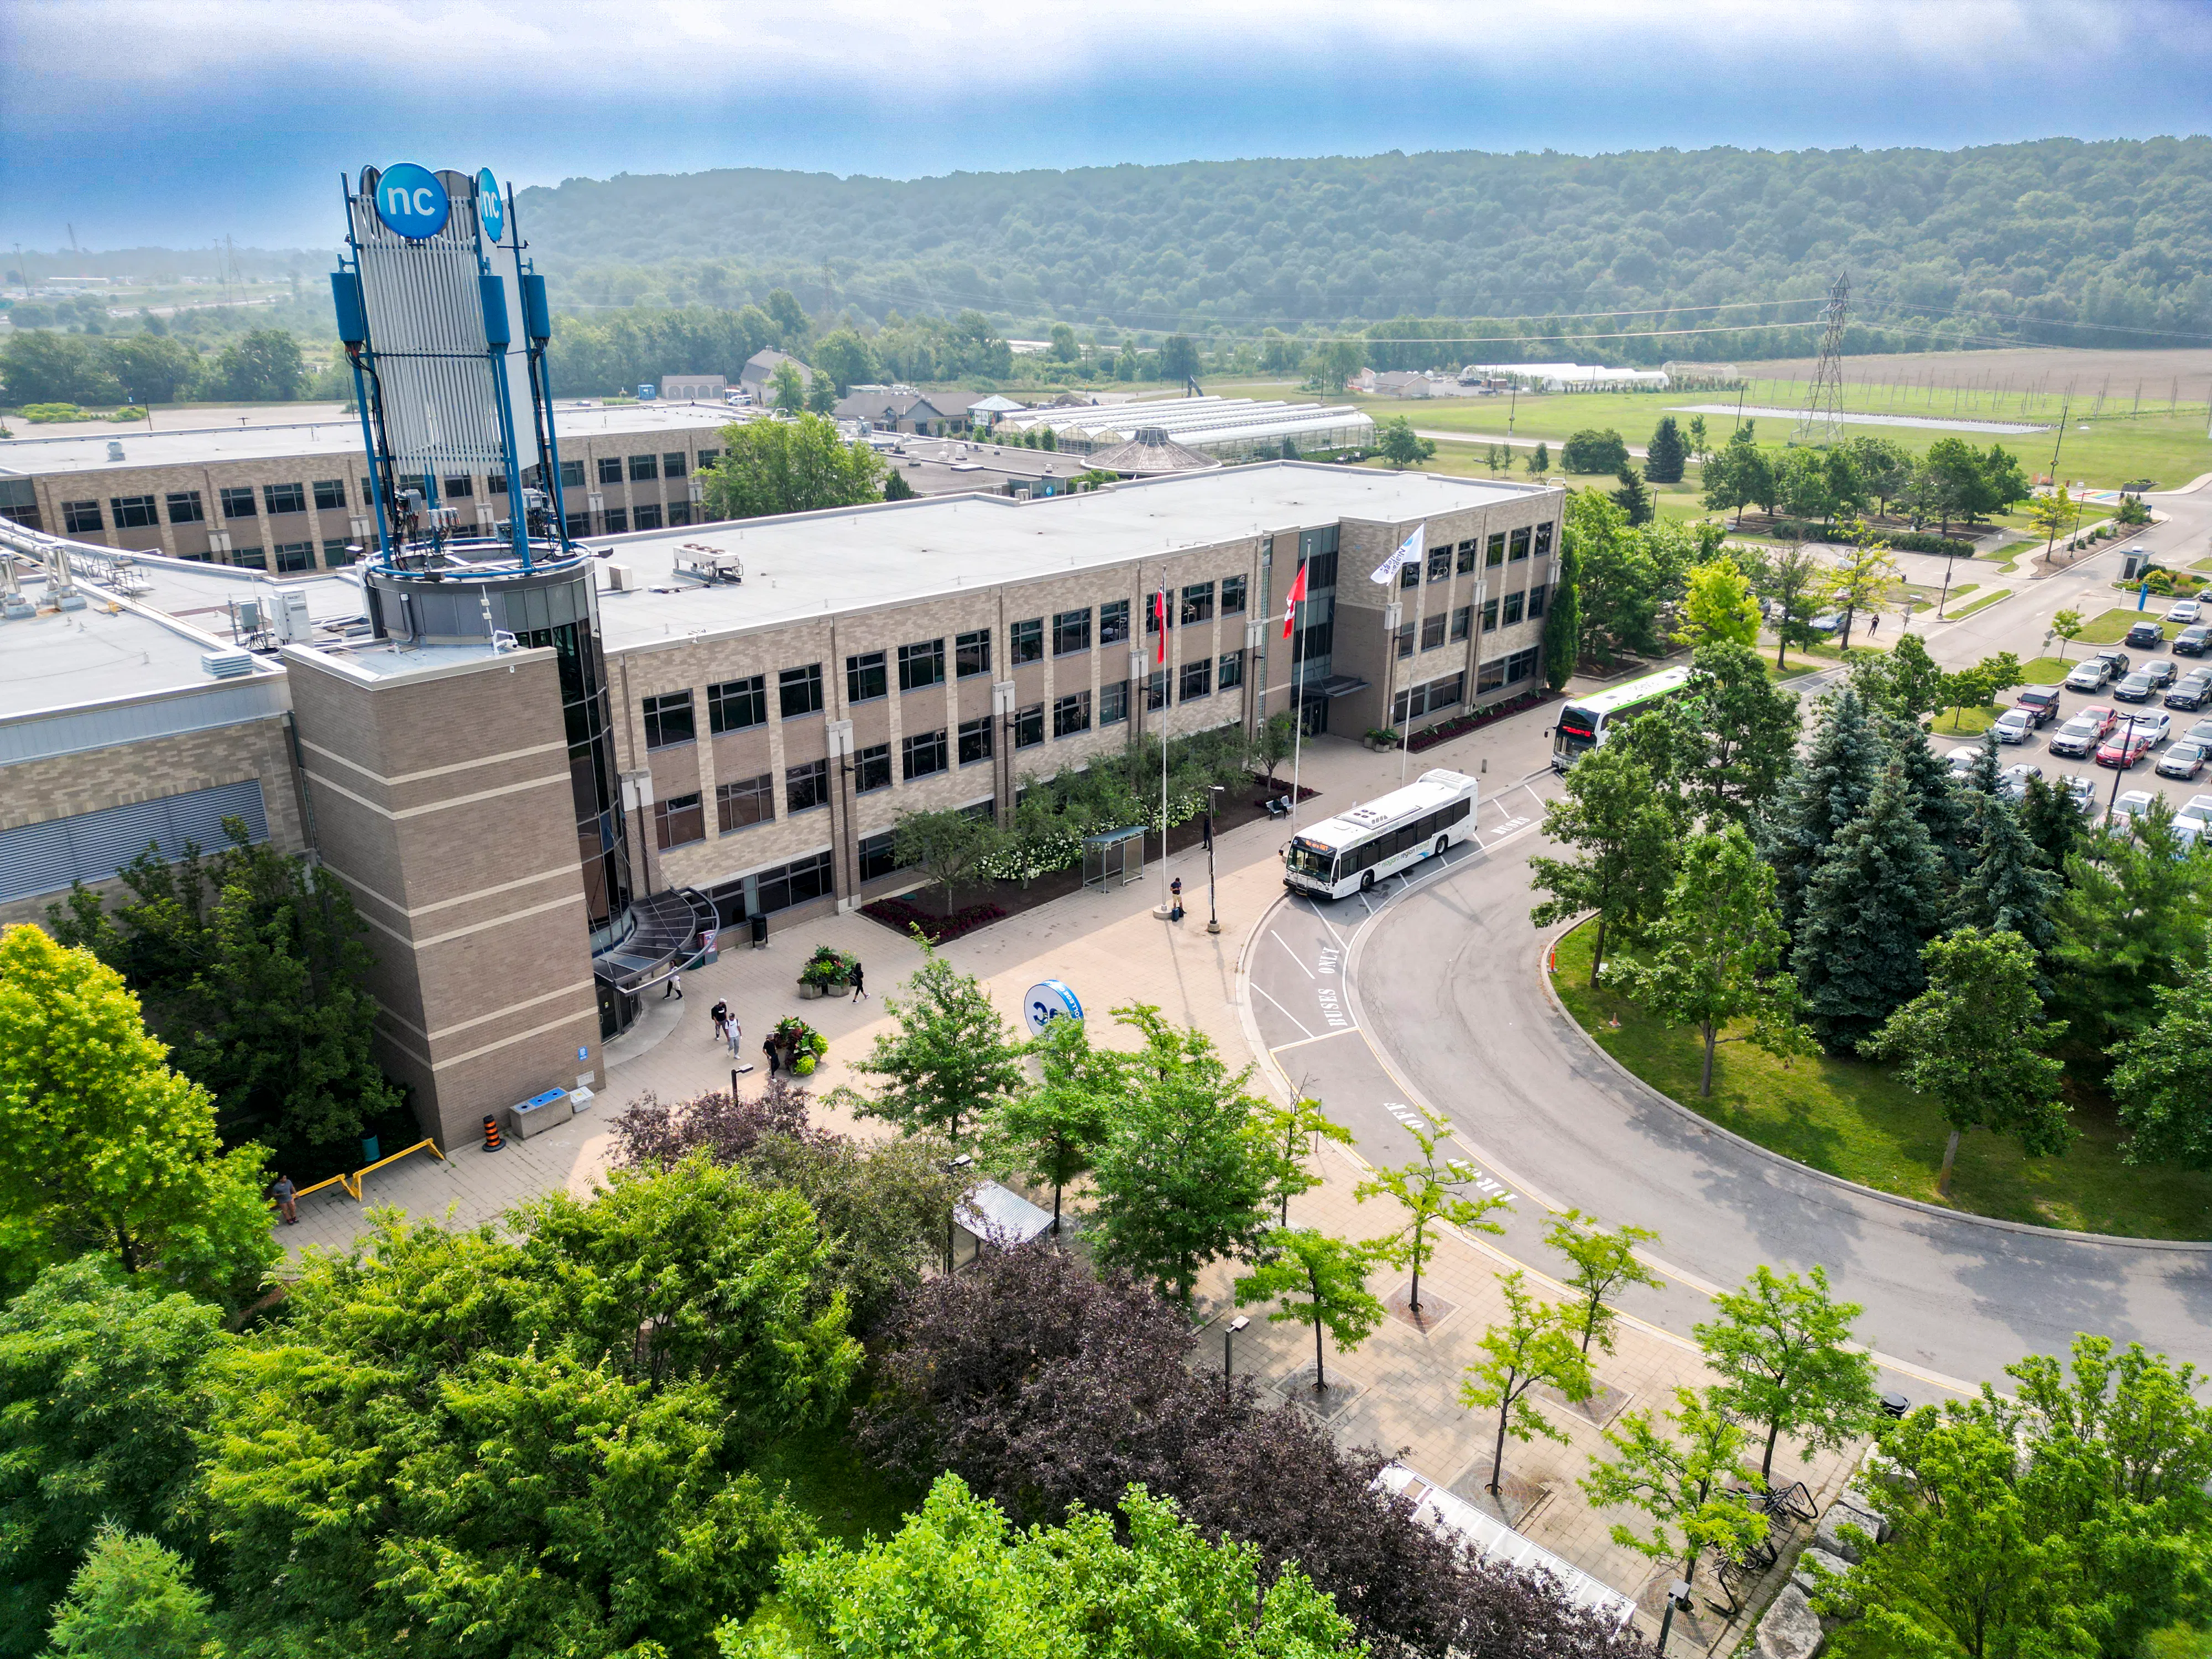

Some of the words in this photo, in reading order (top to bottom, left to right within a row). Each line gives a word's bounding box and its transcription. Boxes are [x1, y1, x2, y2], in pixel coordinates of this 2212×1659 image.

[388, 187, 435, 216] nc
[482, 190, 499, 219] nc
[1490, 816, 1531, 834] BUSES
[1382, 855, 1400, 868] niagara
[1400, 848, 1415, 859] region
[1416, 841, 1430, 852] transit
[1318, 947, 1339, 974] ONLY
[1318, 989, 1348, 1026] BUSES
[1383, 1103, 1425, 1129] OFF
